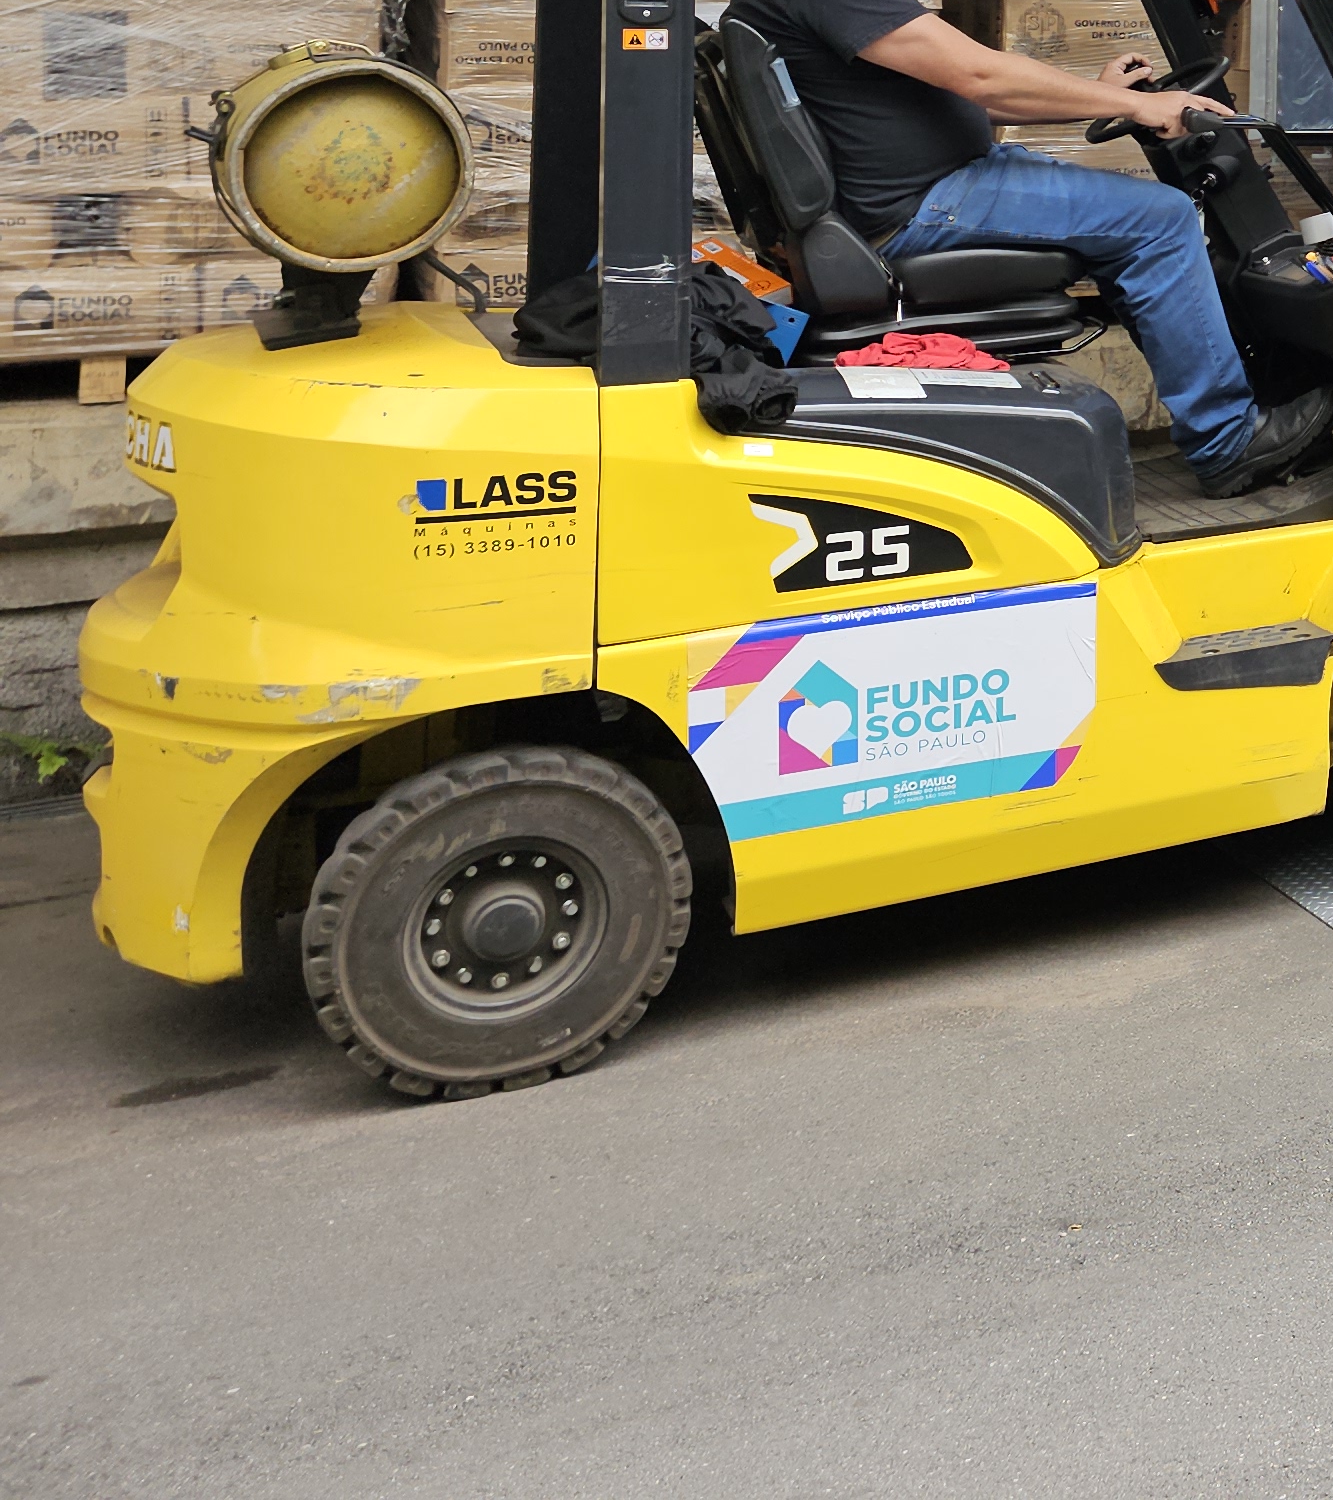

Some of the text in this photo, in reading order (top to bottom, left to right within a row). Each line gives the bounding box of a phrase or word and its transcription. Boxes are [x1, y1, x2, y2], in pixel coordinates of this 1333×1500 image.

[478, 42, 516, 51] PAULO
[453, 470, 578, 510] LASS
[414, 518, 578, 537] Máquinas
[413, 534, 578, 560] (15) 3389-1010
[825, 524, 910, 582] 25
[821, 593, 976, 624] Serviço Público Estadual
[867, 668, 1010, 714] FUNDO
[866, 696, 1016, 742] SOCIAL
[866, 730, 986, 761] SÃO PAULO
[893, 790, 922, 799] GOVERNO
[894, 775, 957, 794] SÃO PAULO
